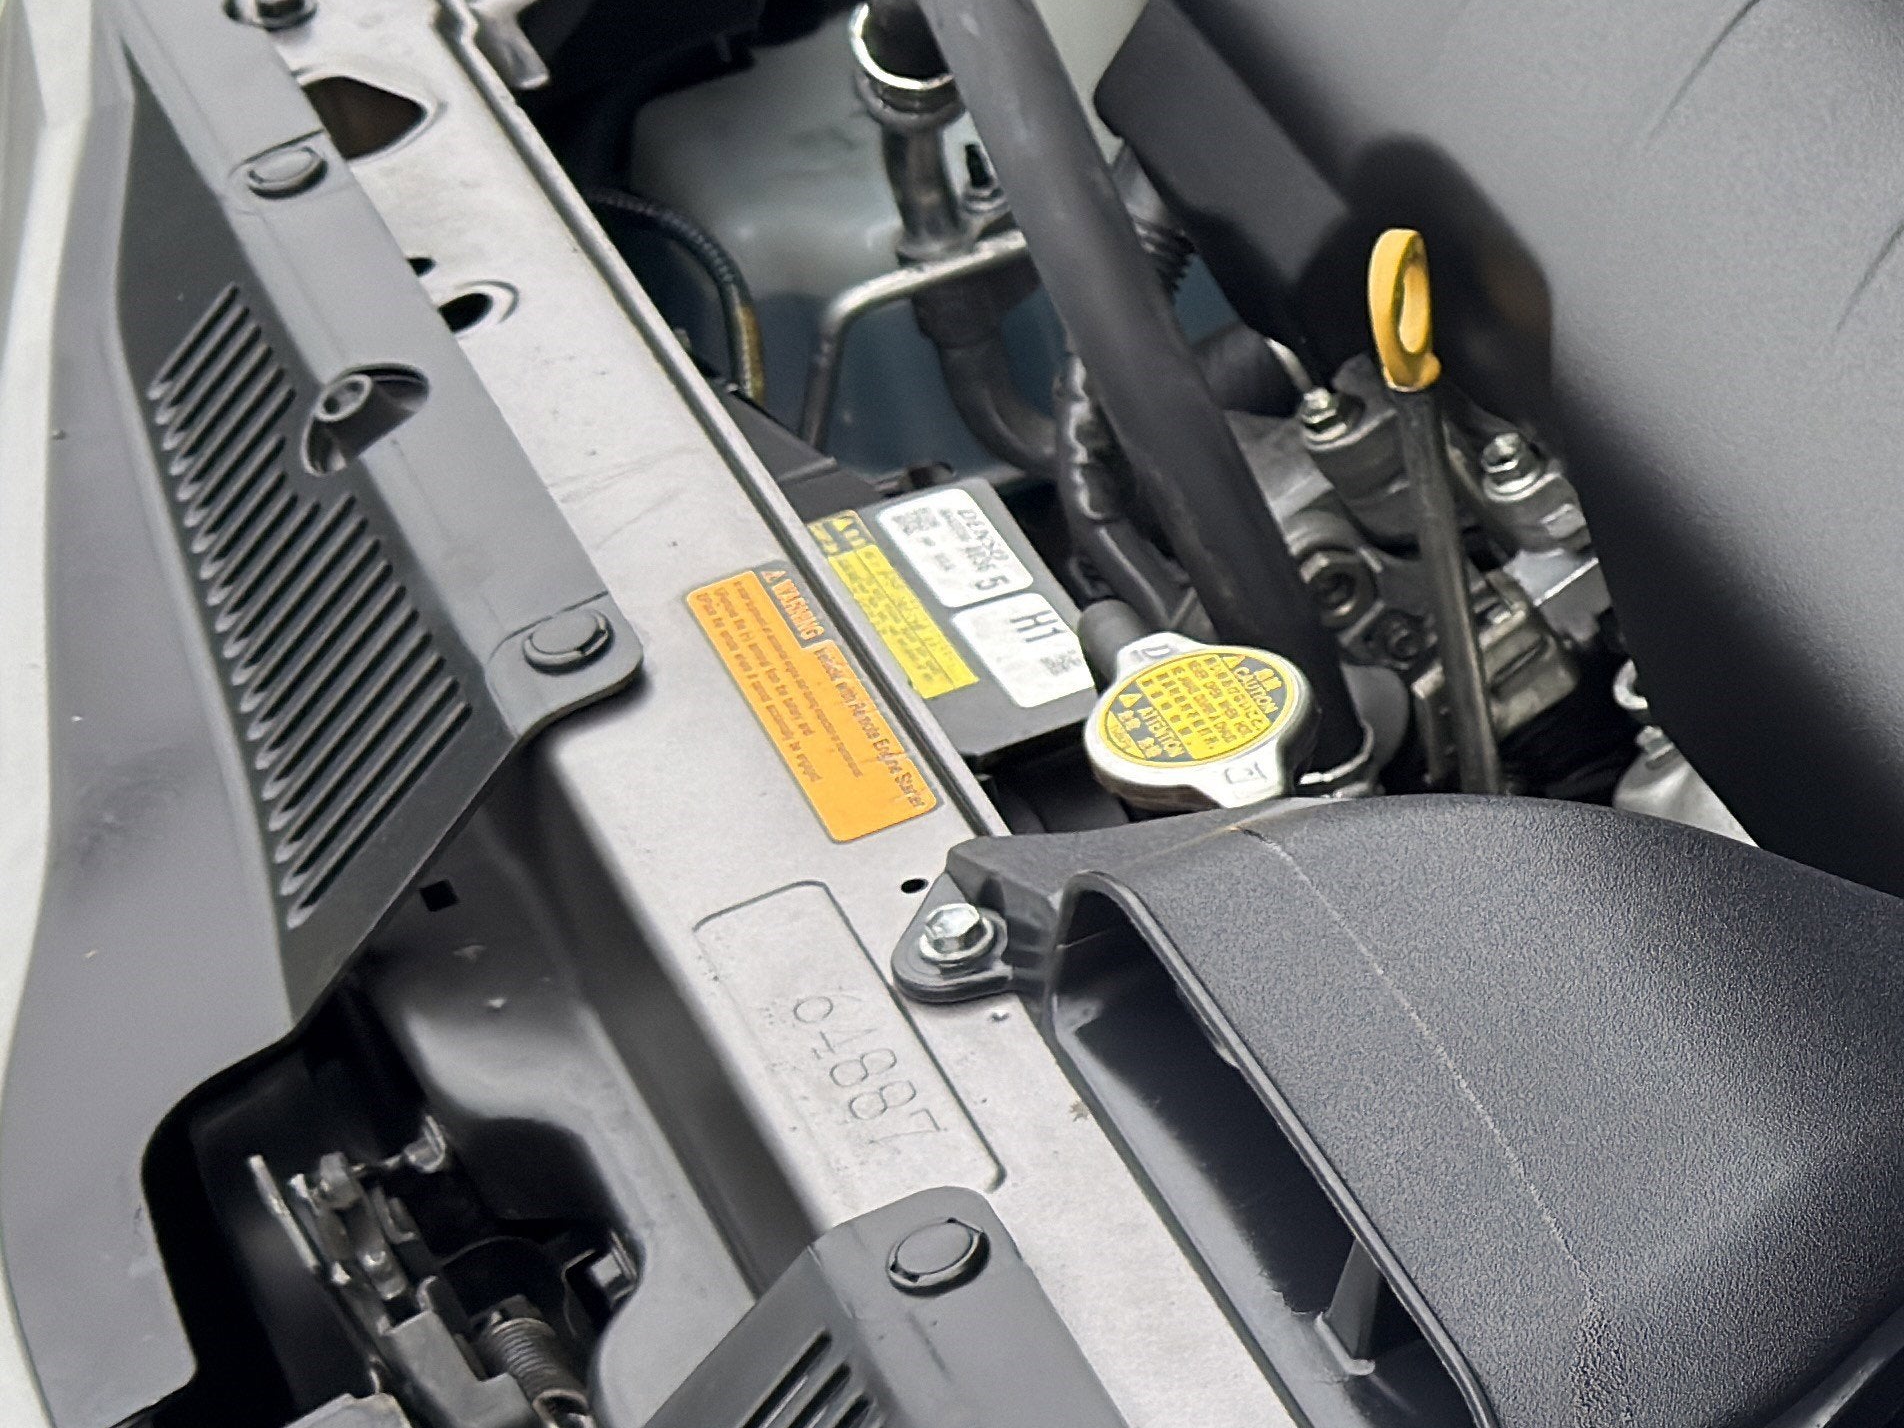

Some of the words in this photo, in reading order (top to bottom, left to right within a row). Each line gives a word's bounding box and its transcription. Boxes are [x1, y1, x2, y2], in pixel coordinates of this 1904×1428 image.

[770, 575, 824, 643] WARNING
[1231, 662, 1279, 716] CAUTION
[1133, 702, 1187, 761] ATTENTION
